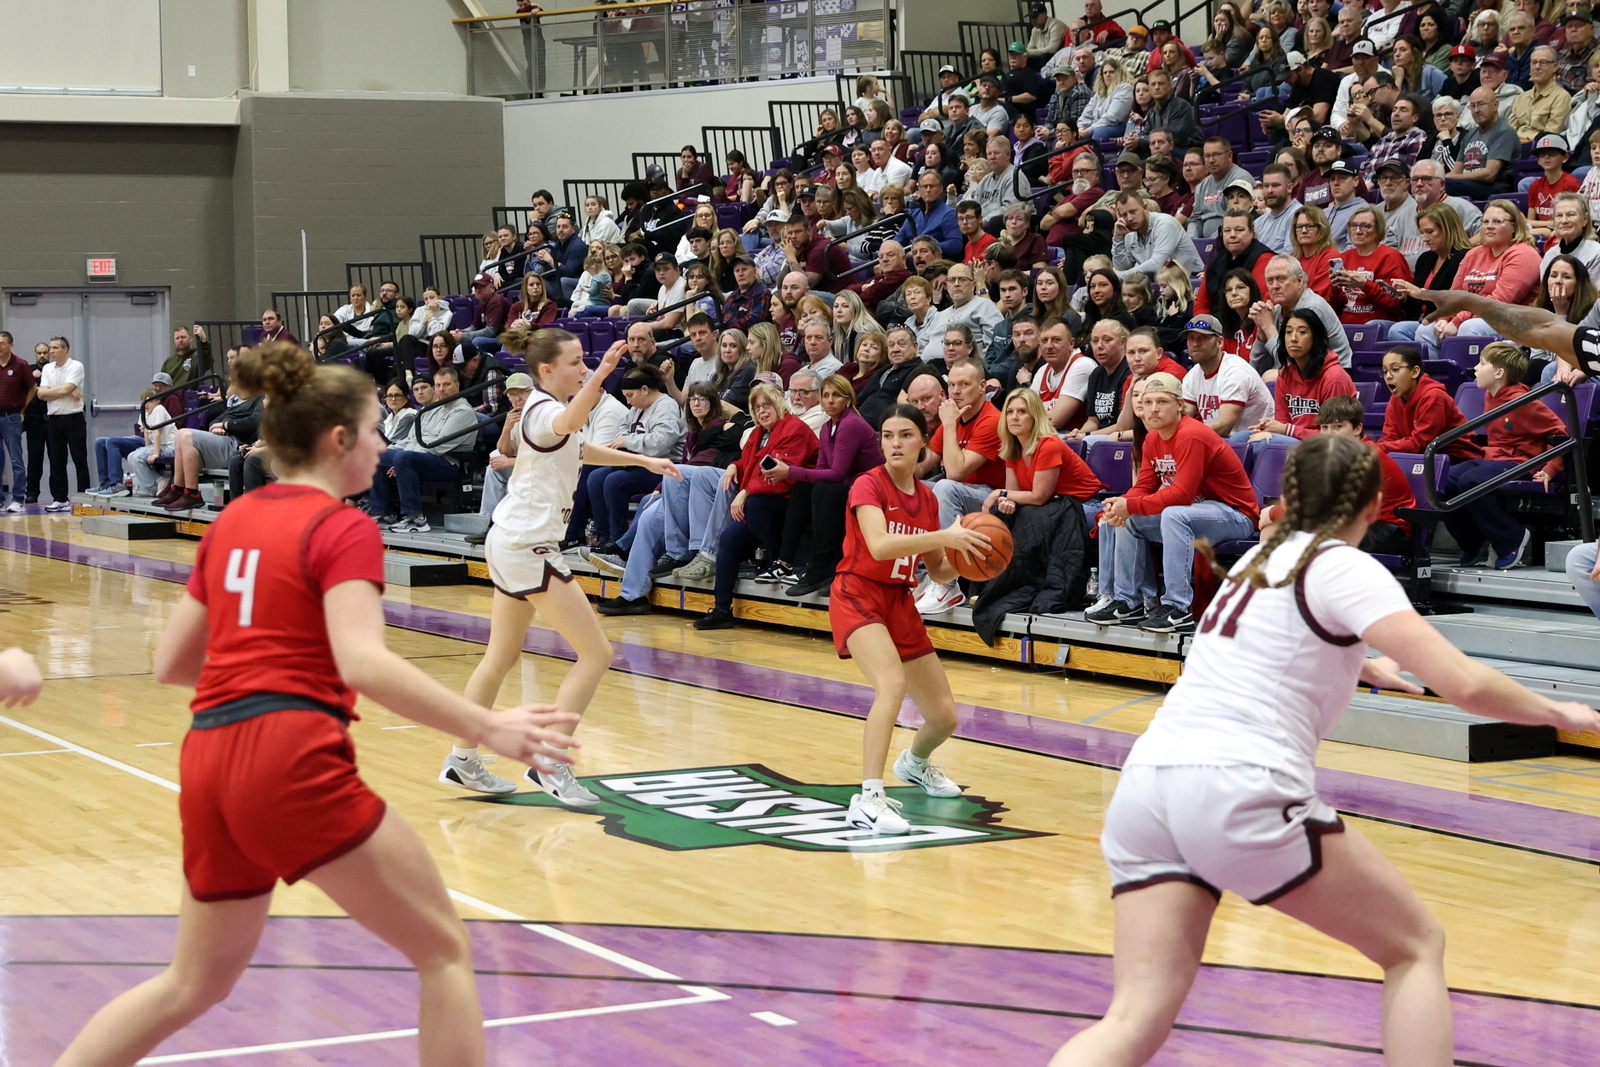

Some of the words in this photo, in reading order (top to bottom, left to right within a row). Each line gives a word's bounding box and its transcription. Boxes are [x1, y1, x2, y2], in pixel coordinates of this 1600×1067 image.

[93, 260, 112, 274] EXIT
[1116, 451, 1123, 459] 29
[1414, 464, 1423, 473] 33
[889, 521, 929, 535] BELLE
[532, 546, 551, 555] G
[1421, 568, 1428, 577] A
[224, 548, 261, 627] 4
[1200, 578, 1257, 639] 31
